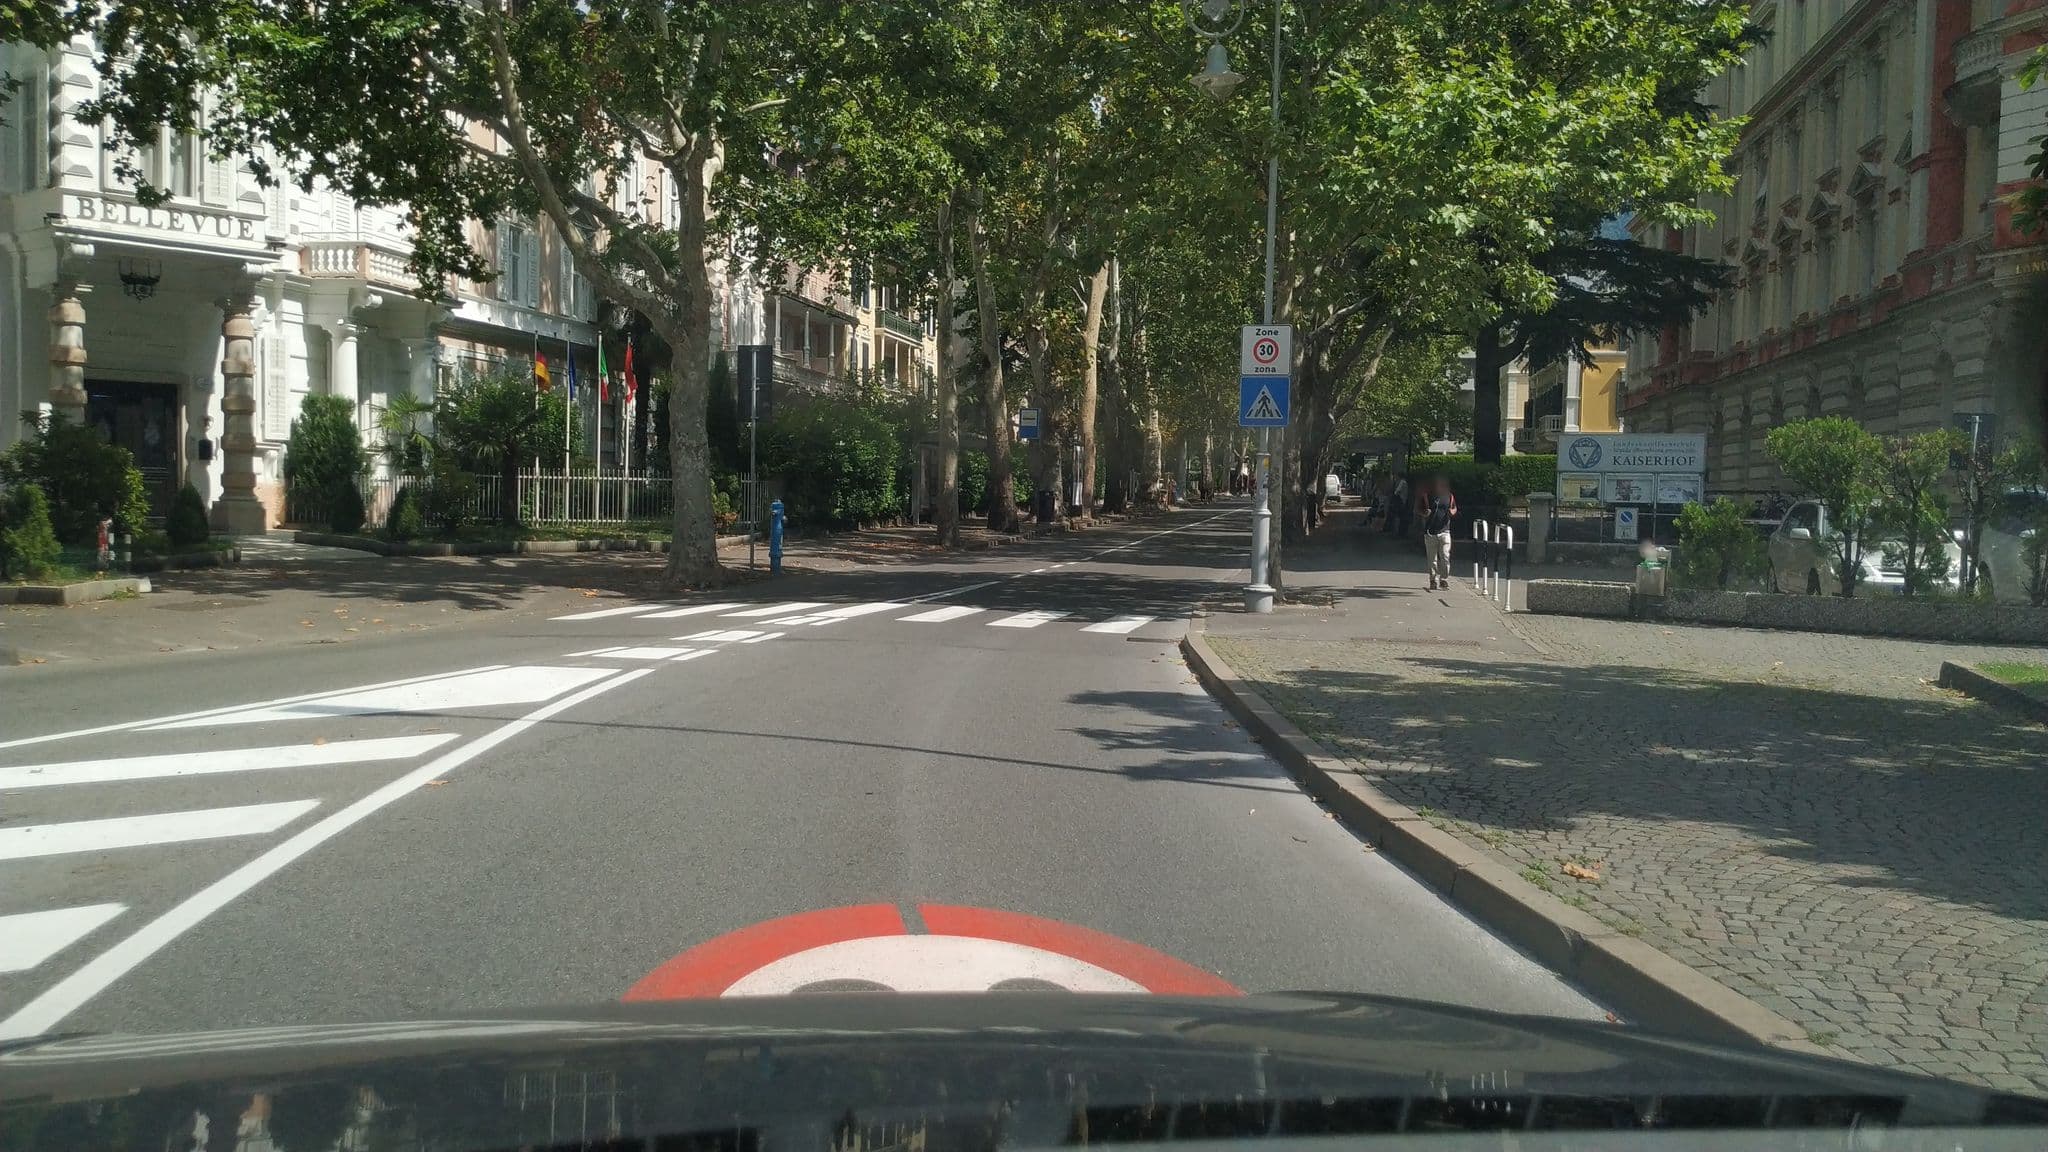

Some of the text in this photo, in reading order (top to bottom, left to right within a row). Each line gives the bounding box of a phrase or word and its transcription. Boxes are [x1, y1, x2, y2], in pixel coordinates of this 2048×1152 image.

[77, 197, 255, 241] BELLEVUE
[1255, 328, 1279, 336] Zone
[1259, 344, 1274, 356] 30
[1612, 455, 1697, 467] KAISERHOF
